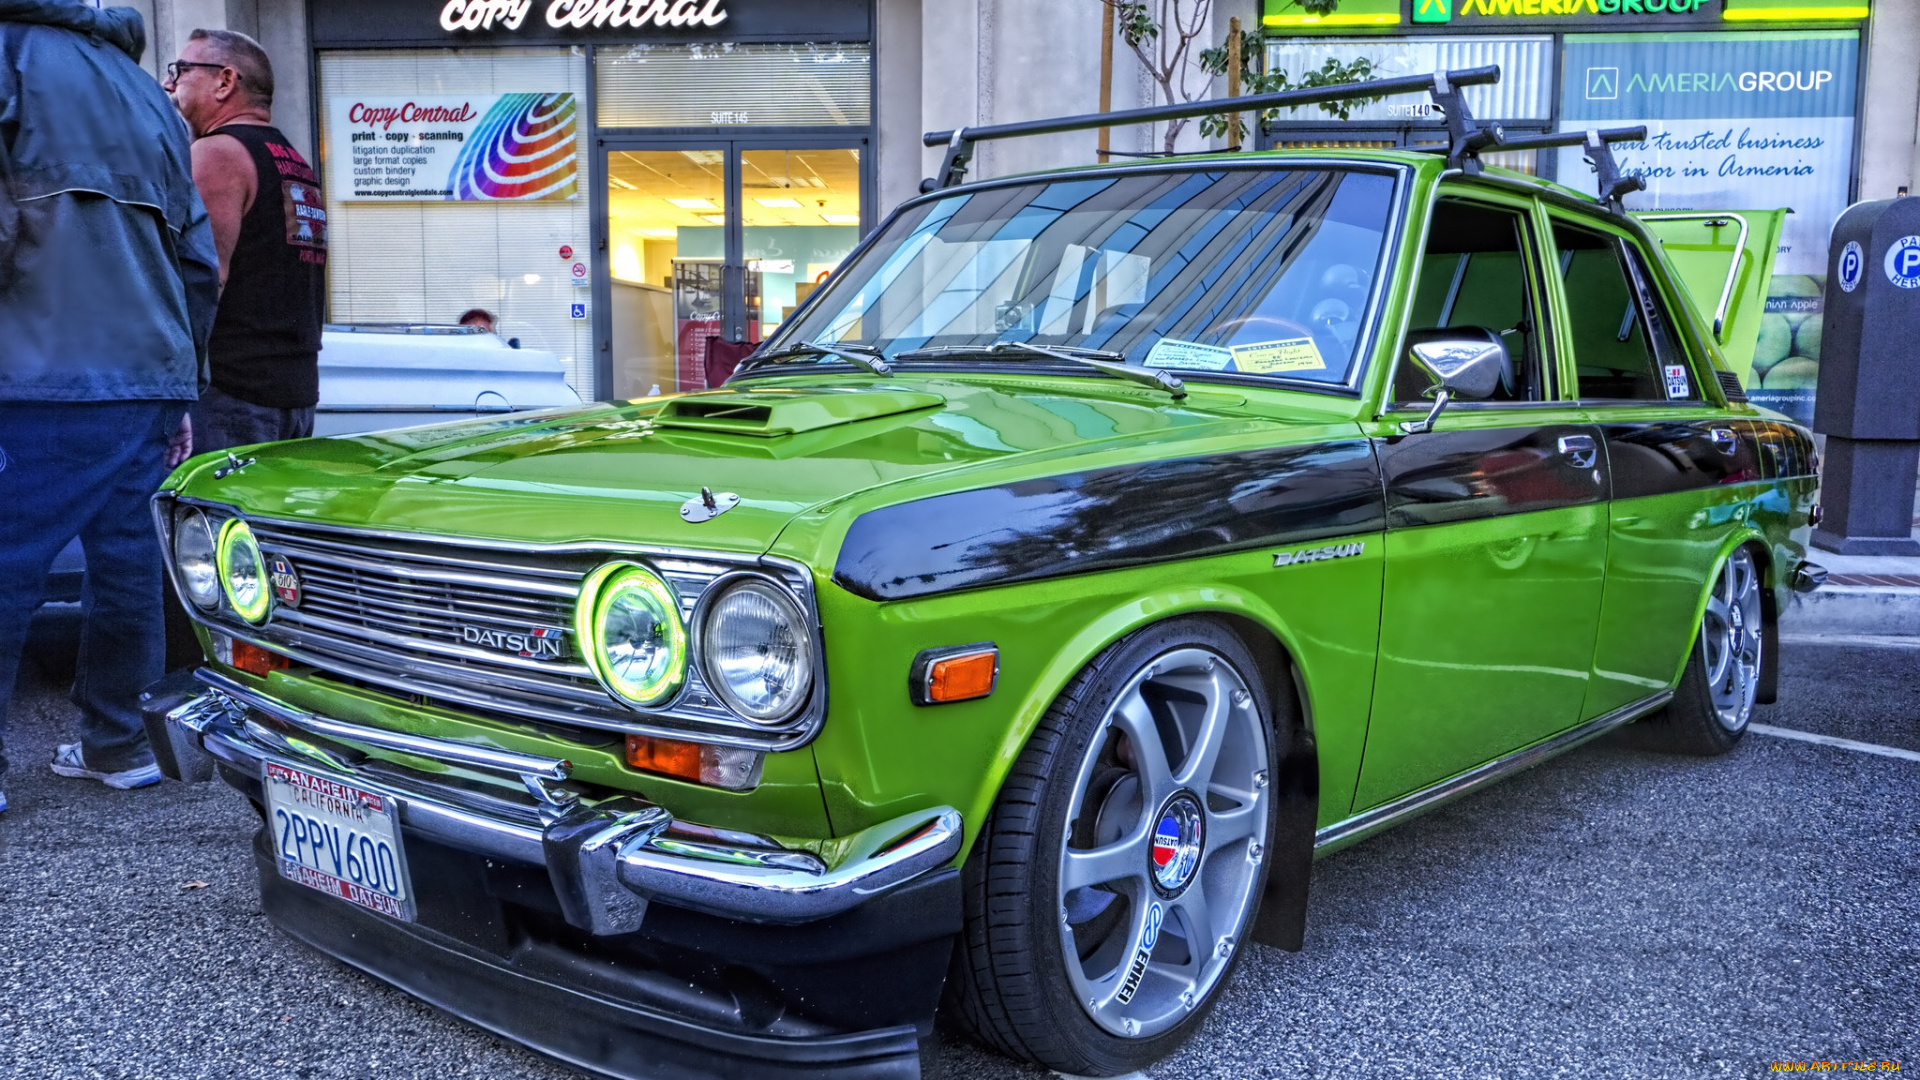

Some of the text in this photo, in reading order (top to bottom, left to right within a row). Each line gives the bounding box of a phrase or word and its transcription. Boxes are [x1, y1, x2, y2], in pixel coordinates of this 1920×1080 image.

[1626, 70, 1832, 93] AMERIAGROUP
[349, 101, 477, 131] Copy Central
[1387, 104, 1430, 117] SUITE 140
[711, 111, 748, 124] SUITE 145
[351, 130, 464, 143] print copy scanning
[1607, 126, 1825, 151] our trusted business
[352, 145, 435, 156] litigation duplication
[353, 155, 427, 166] large format copies
[1682, 161, 1709, 178] in
[1718, 154, 1815, 178] Armenia
[353, 166, 416, 176] custom bindery
[354, 176, 411, 187] graphic design
[354, 189, 453, 198] www.copycentralglendale.com
[1846, 242, 1859, 253] PAY
[1841, 279, 1858, 292] HERE
[1892, 274, 1920, 288] HER
[1790, 300, 1818, 310] Apple
[1667, 376, 1687, 387] DATSUN
[1272, 541, 1365, 567] DATSUN
[277, 574, 292, 589] 510
[463, 625, 561, 656] DATSUN
[290, 770, 360, 800] ANAHEIM
[293, 787, 364, 823] CALIFORNIA
[1154, 836, 1178, 847] DATSUN
[276, 808, 398, 896] 2PPV600
[286, 861, 403, 920] ANAHEIM DATSUN
[1117, 949, 1149, 1003] ENKEI
